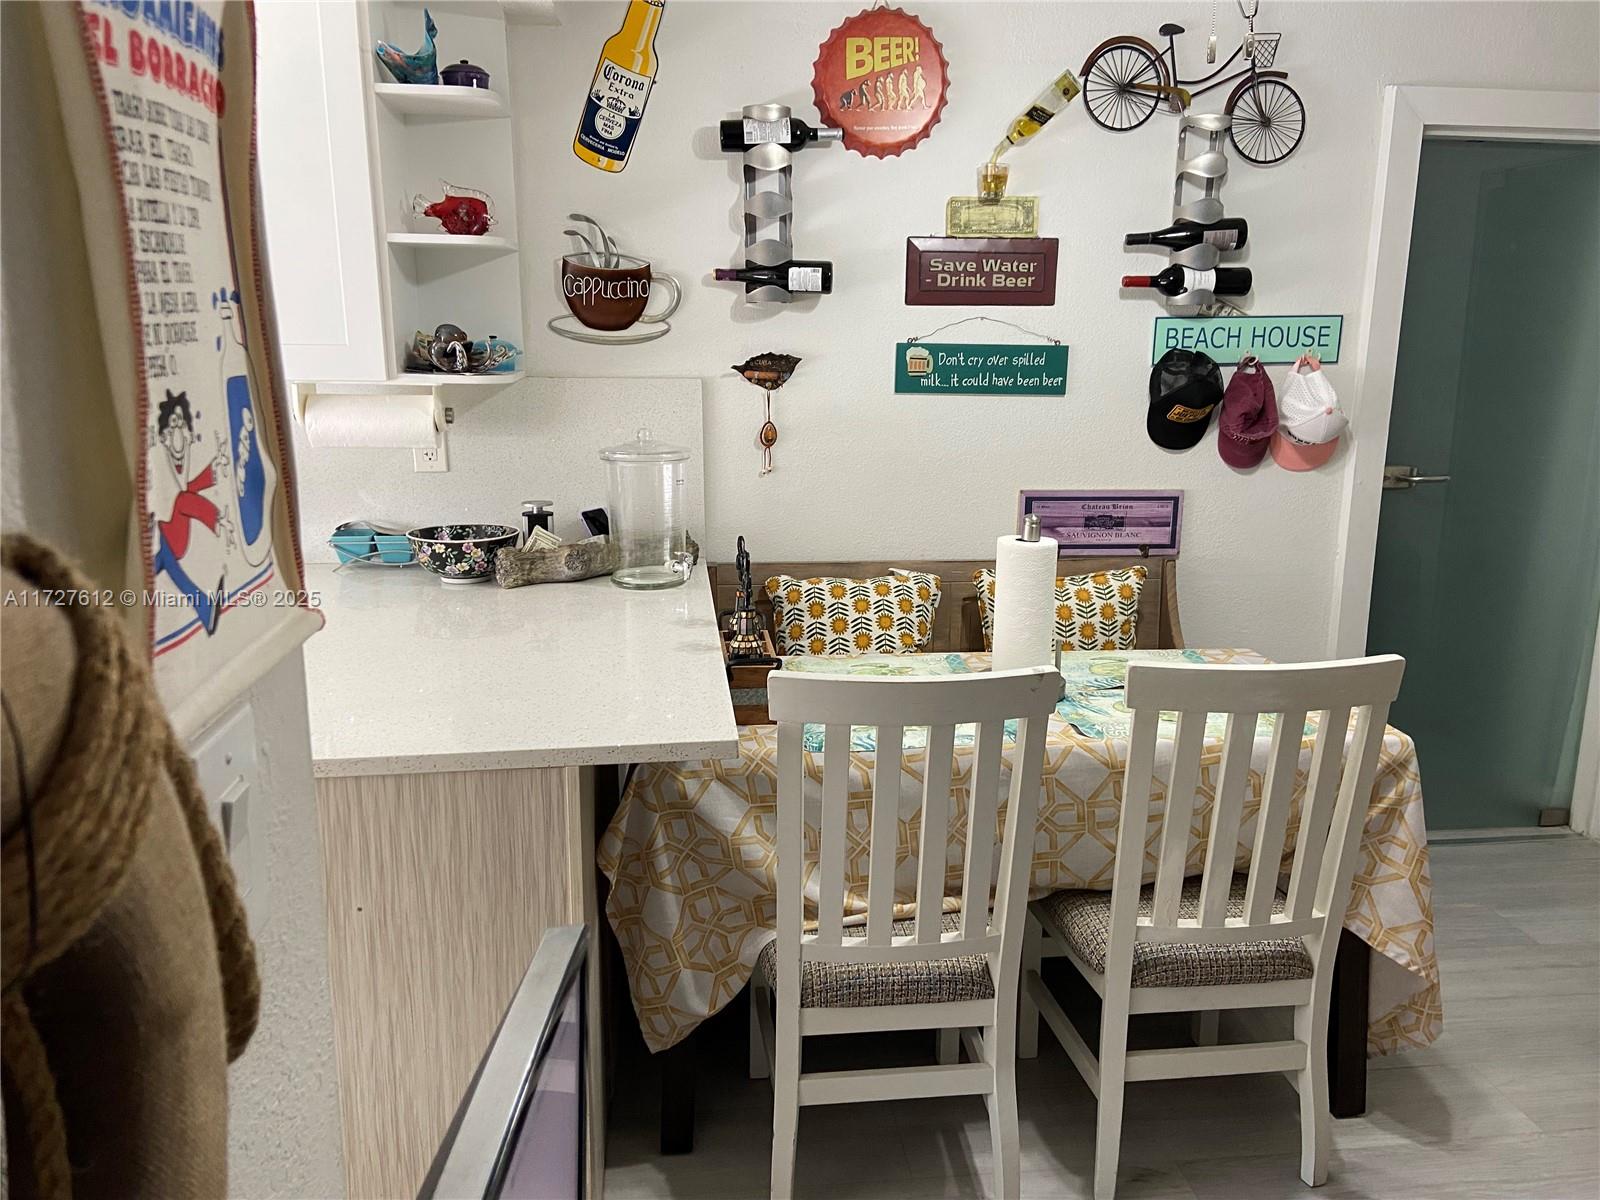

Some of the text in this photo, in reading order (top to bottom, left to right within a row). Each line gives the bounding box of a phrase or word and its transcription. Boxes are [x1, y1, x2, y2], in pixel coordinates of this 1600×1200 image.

[845, 36, 920, 80] BEER!
[603, 63, 645, 91] Corona
[608, 82, 635, 100] Extra
[599, 115, 622, 128] CERVEZA
[603, 123, 615, 131] MAS
[930, 258, 1038, 273] Save Water
[937, 273, 986, 287] Drink
[992, 274, 1036, 287] Beer
[563, 273, 649, 306] Cappuccino
[1165, 325, 1331, 350] BEACH HOUSE
[938, 352, 1046, 368] Don't cry over spilled
[962, 372, 989, 387] could
[992, 373, 1014, 387] have
[1017, 373, 1040, 387] been
[1042, 373, 1064, 387] beer
